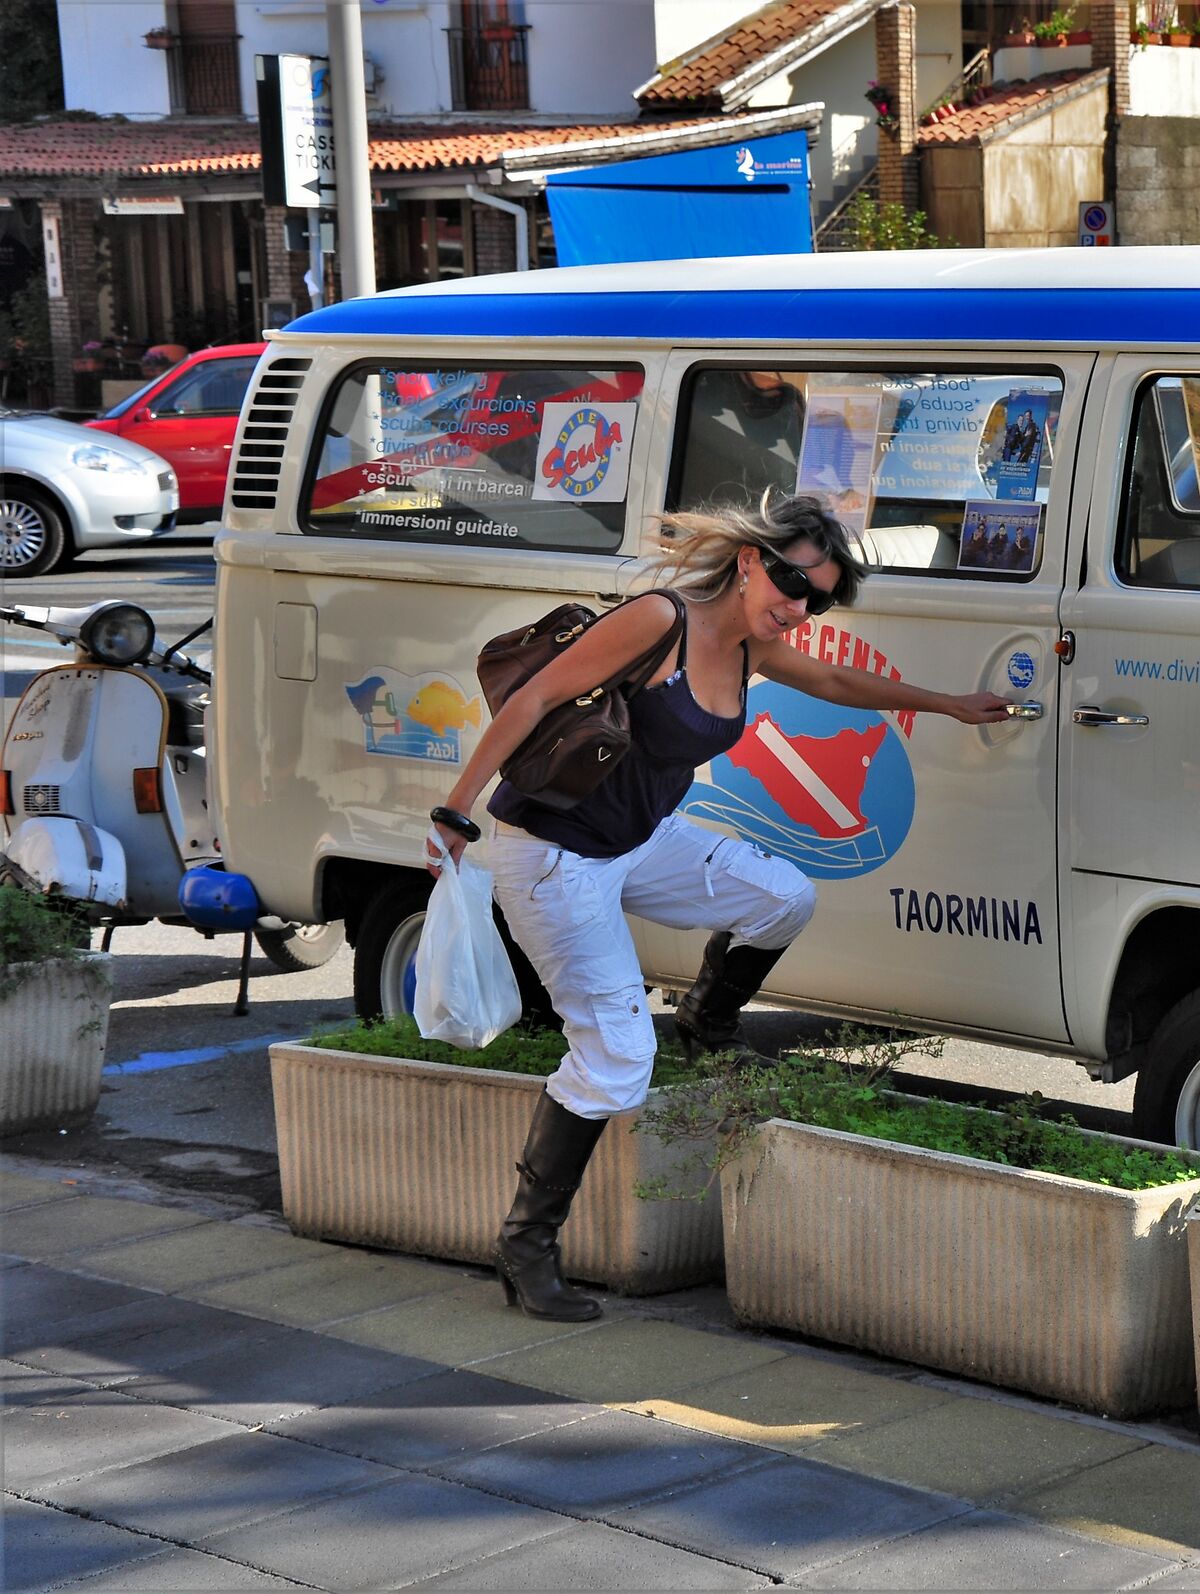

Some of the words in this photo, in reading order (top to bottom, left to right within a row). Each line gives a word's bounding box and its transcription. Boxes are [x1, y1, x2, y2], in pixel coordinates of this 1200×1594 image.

[296, 134, 335, 150] CASS
[438, 420, 510, 437] courses
[560, 412, 597, 444] DIVE
[456, 476, 472, 491] in
[477, 478, 524, 496] barca
[455, 519, 519, 538] guidate
[426, 741, 455, 760] PADI
[890, 888, 1043, 946] TAORMINA
